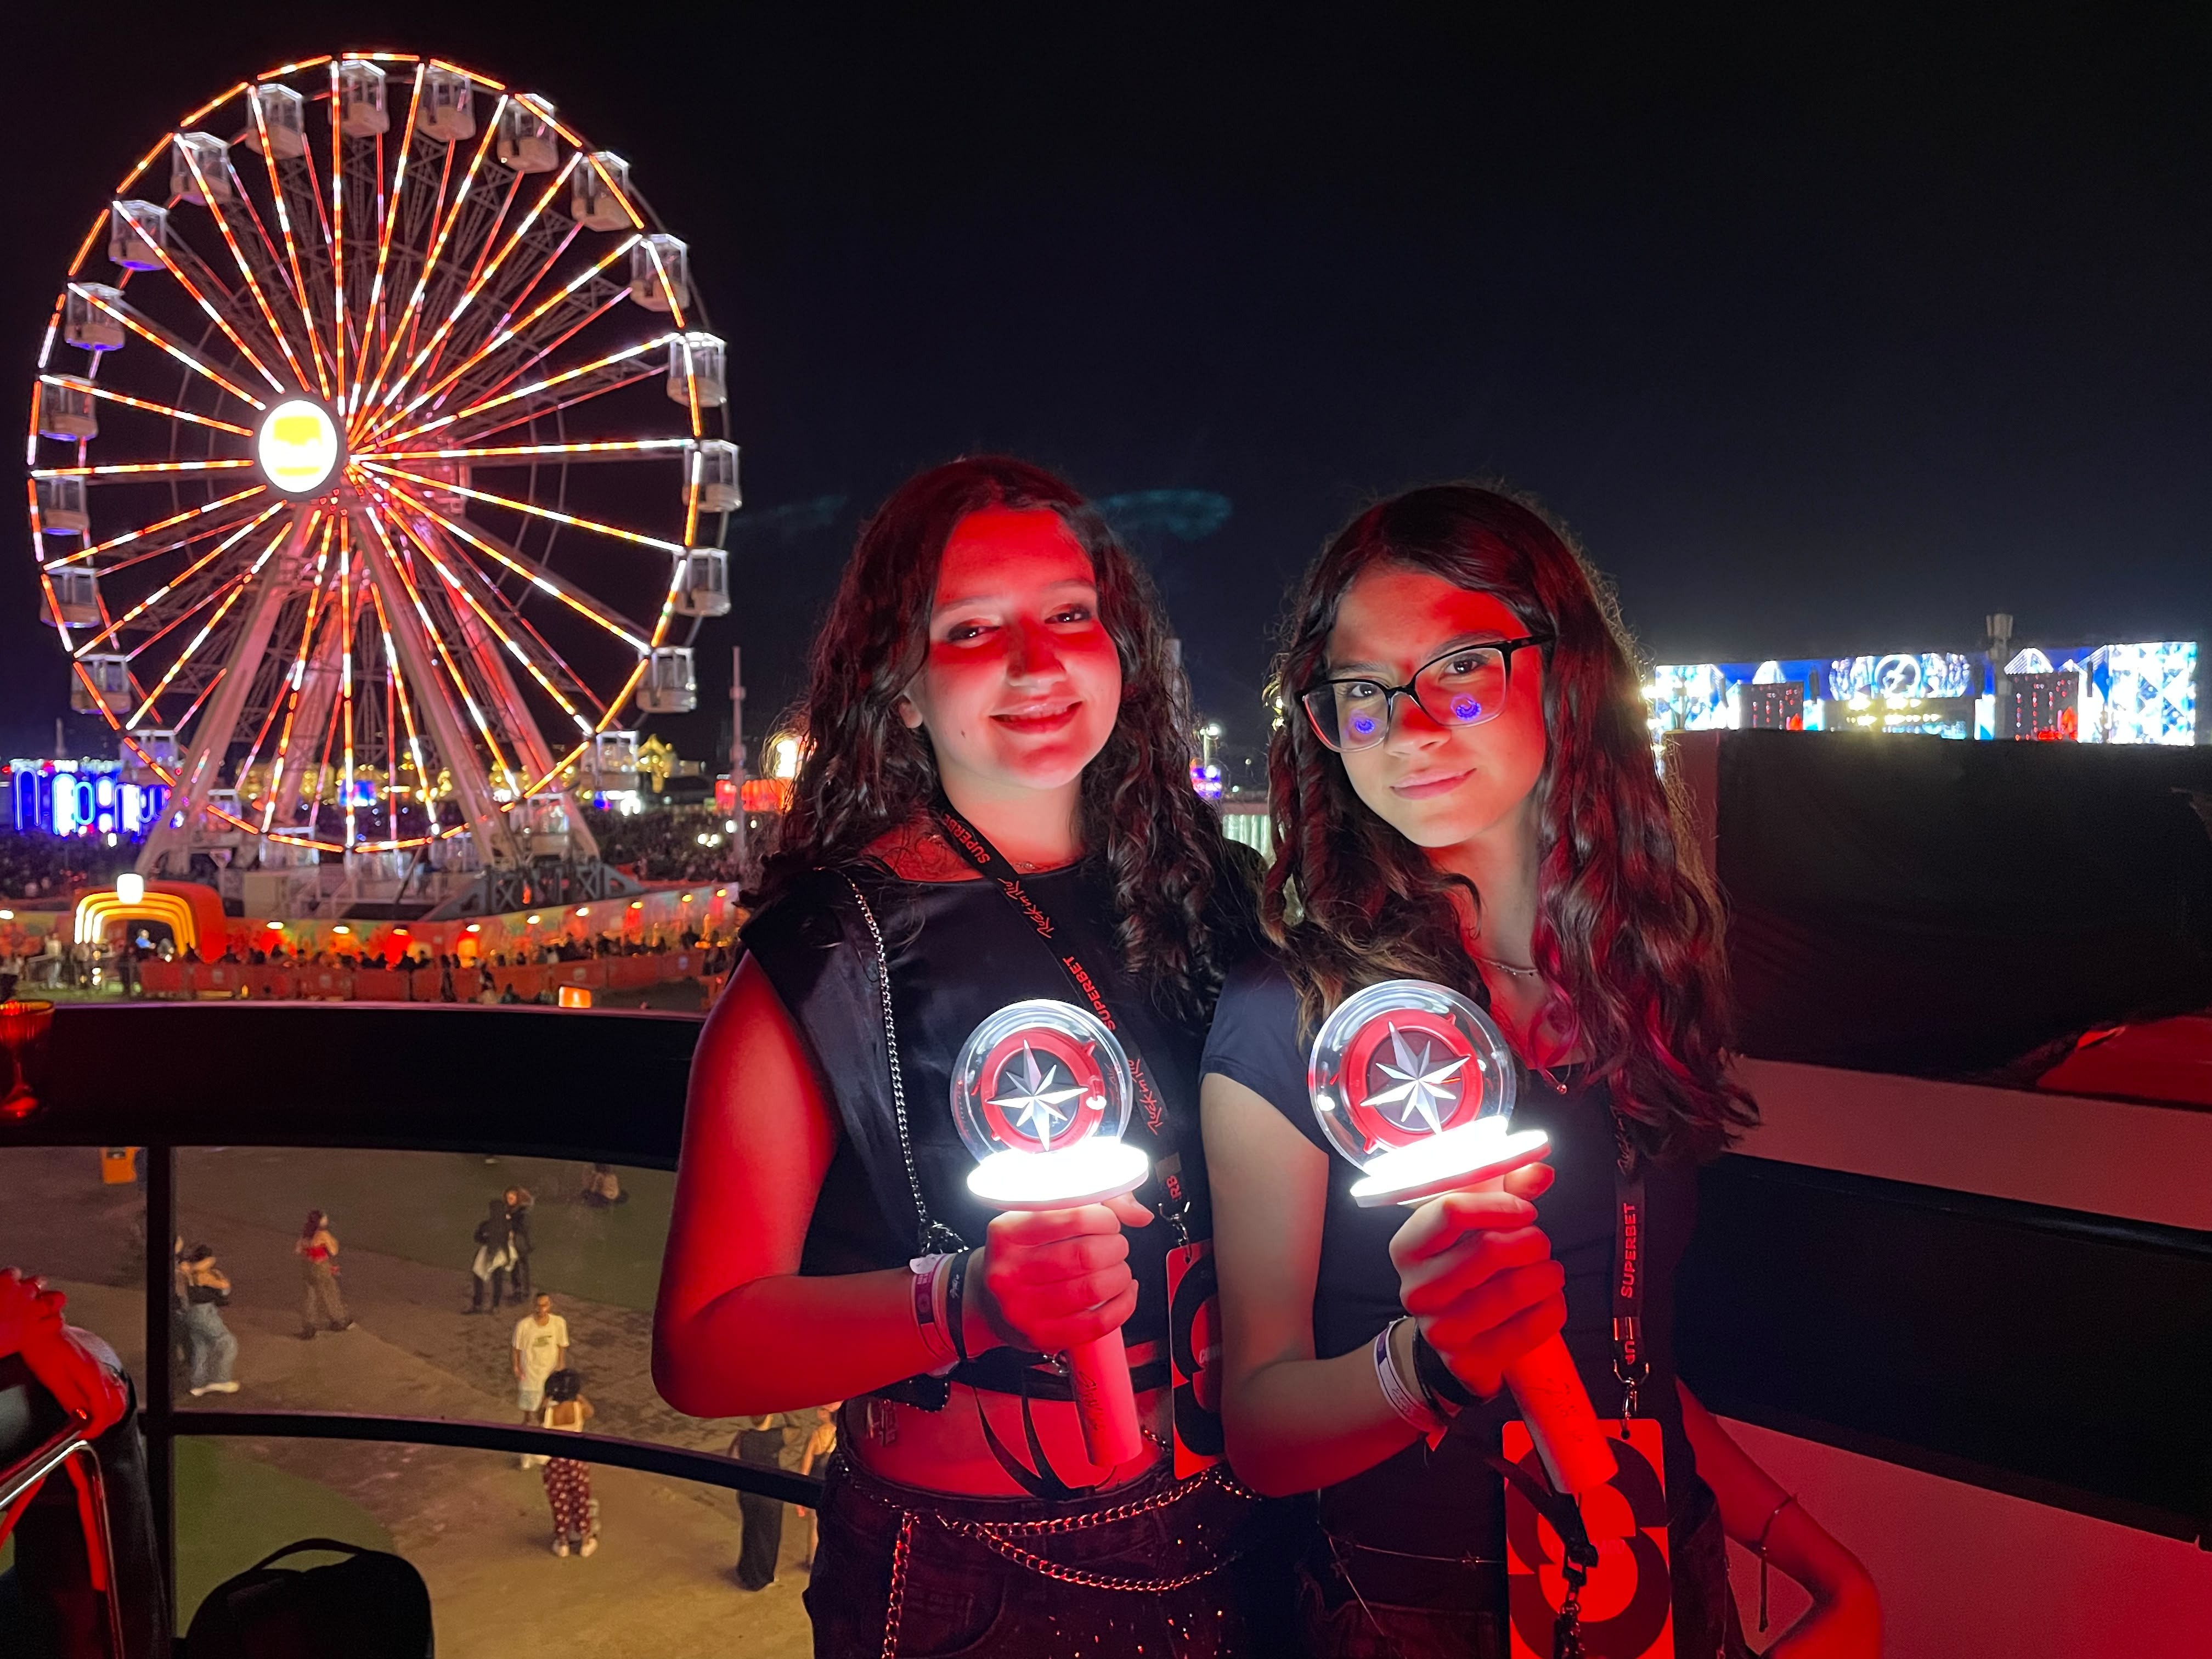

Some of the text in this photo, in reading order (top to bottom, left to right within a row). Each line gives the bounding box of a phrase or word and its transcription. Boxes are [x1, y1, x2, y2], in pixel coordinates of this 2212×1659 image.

[944, 813, 990, 864] SUPERBE
[1062, 956, 1116, 1031] SUPERBET
[1621, 1203, 1637, 1298] SUPERBET
